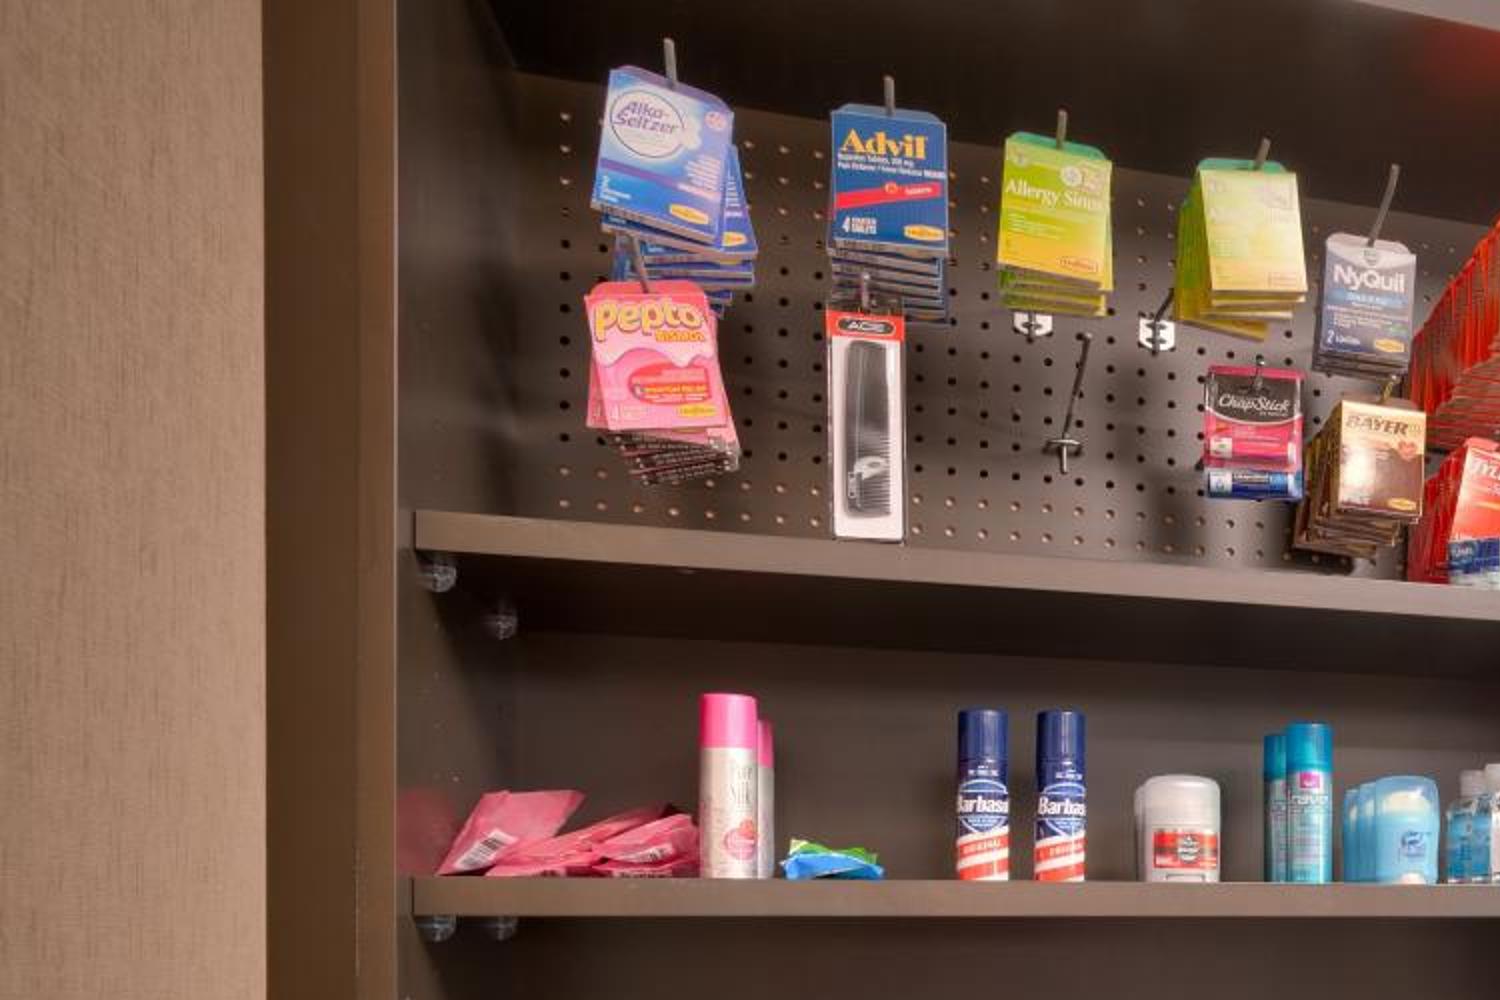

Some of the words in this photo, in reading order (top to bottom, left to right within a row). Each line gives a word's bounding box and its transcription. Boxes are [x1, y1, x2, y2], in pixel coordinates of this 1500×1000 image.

[613, 112, 680, 135] Seltzer
[841, 128, 927, 160] Advil
[1006, 178, 1057, 208] Allergy
[1333, 263, 1406, 293] NyQuil
[595, 298, 704, 342] pepto
[1219, 393, 1290, 412] ChapStick
[1346, 414, 1409, 436] BAYER
